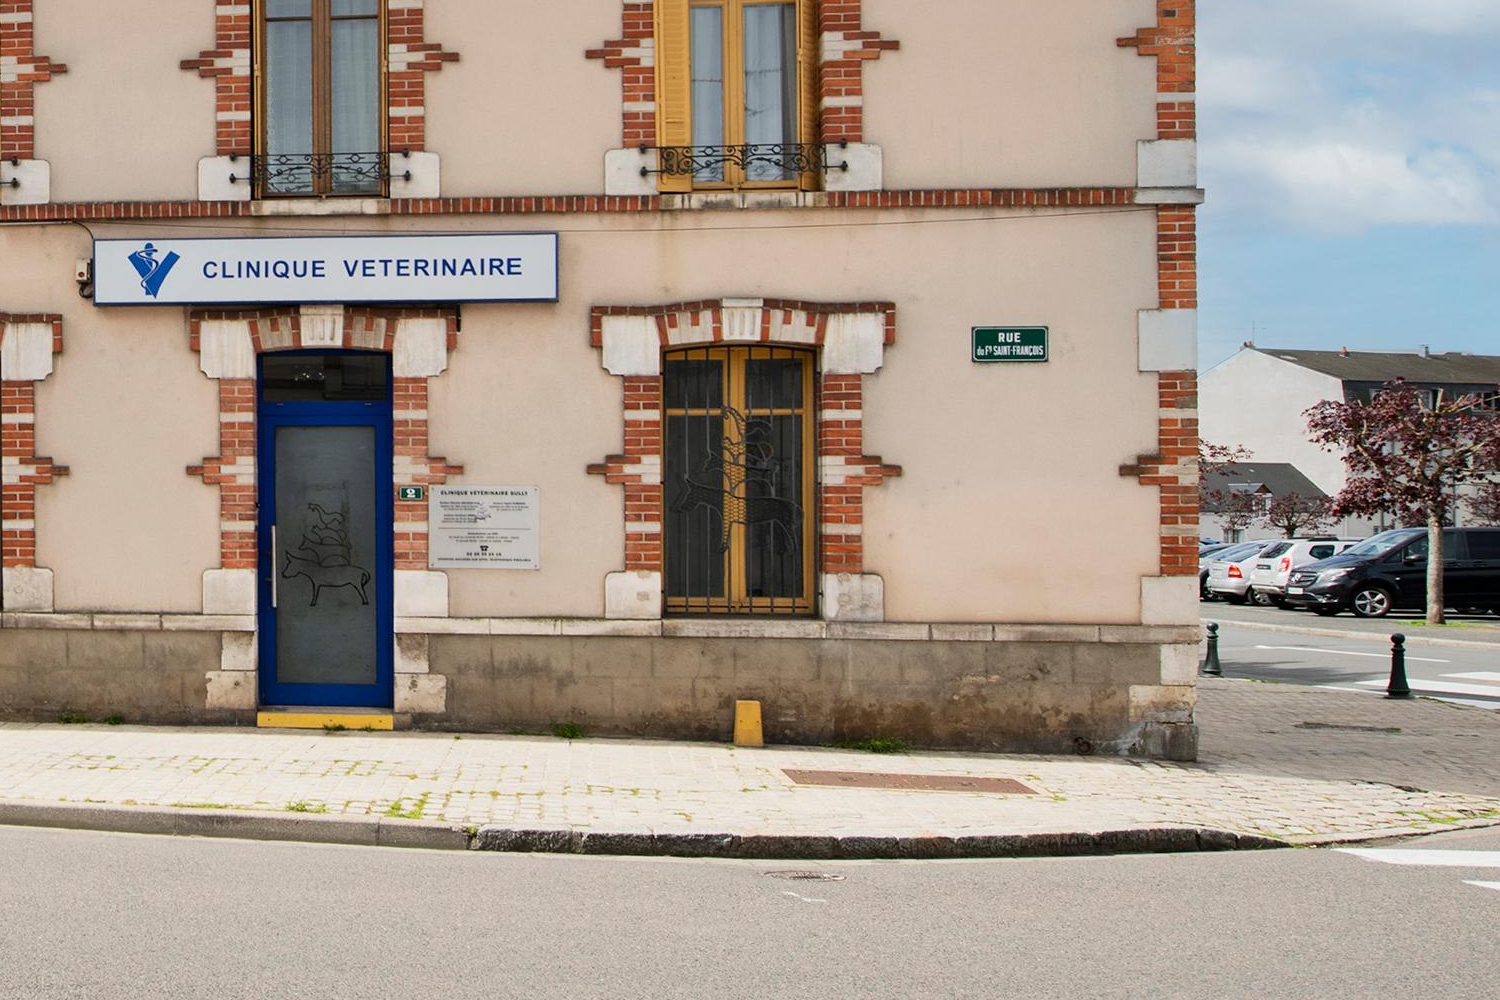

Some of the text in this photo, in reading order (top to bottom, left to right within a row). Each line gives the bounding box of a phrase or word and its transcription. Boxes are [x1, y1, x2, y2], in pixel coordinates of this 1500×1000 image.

[202, 257, 523, 280] CLINIQUE VETERINAIRE
[998, 332, 1021, 343] RUE
[977, 345, 984, 356] du
